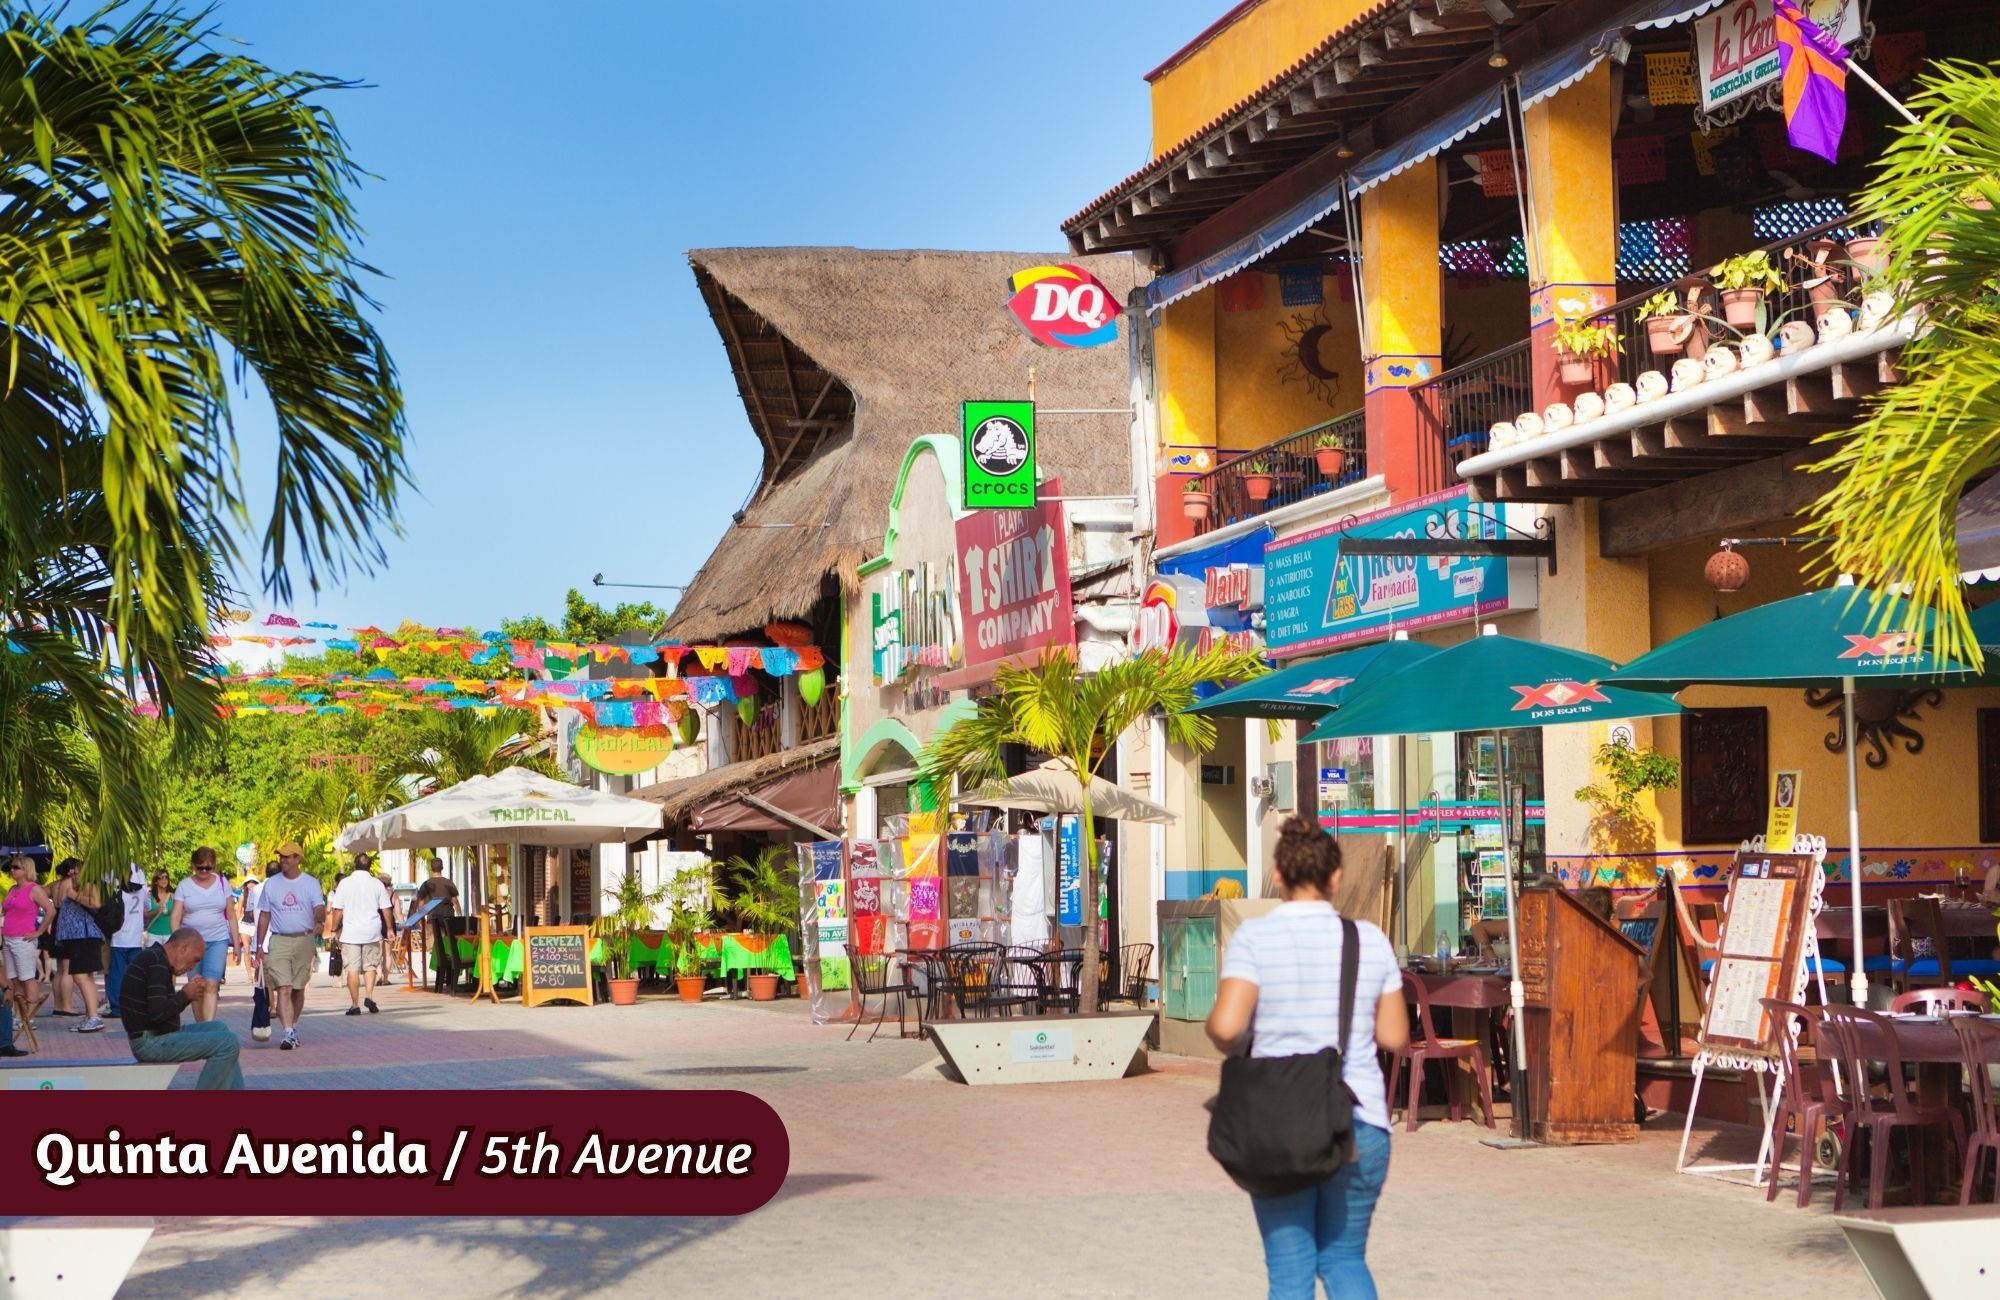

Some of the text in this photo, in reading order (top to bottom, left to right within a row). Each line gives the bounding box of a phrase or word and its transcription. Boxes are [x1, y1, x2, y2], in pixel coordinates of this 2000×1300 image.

[1710, 74, 1752, 101] MEXICAN
[1031, 282, 1104, 328] DQ
[971, 482, 1029, 495] crocs
[999, 510, 1024, 540] PLAYA
[1276, 550, 1311, 568] MASS RELAX
[1276, 567, 1313, 586] ANTIBIOTICS
[1205, 567, 1249, 611] Dairy
[1277, 585, 1311, 603] ANABOLICS
[1277, 606, 1299, 620] VIAGRA
[1332, 594, 1355, 619] LESS
[978, 597, 1054, 650] COMPANY
[1278, 621, 1308, 638] DIET PILLS
[1531, 705, 1592, 719] DOS EQUIS
[582, 735, 671, 751] TROPICAL
[489, 807, 576, 822] TROPICAL
[1060, 838, 1070, 914] infinitum
[129, 896, 140, 914] 2
[530, 935, 582, 947] CERVEZA
[832, 929, 847, 938] AVE
[532, 964, 584, 975] COCKTAIL
